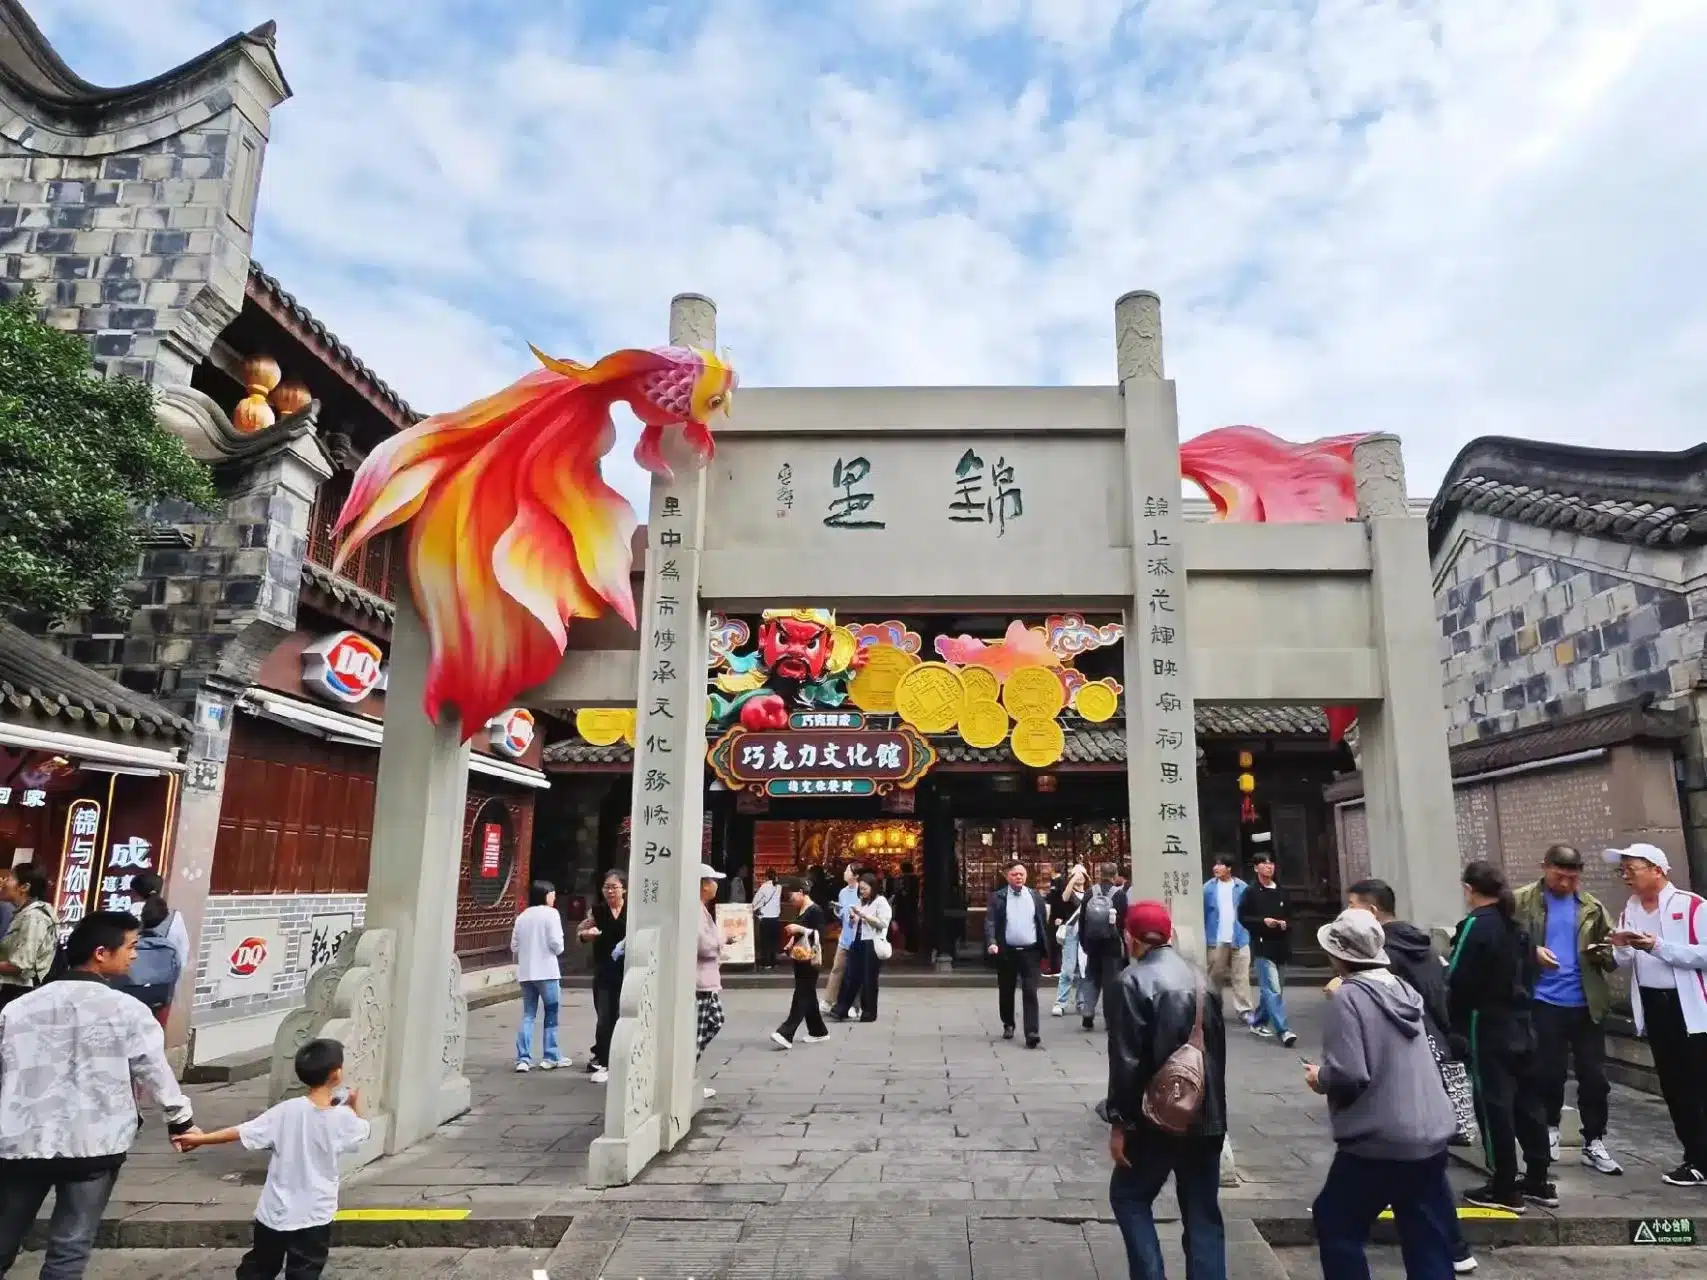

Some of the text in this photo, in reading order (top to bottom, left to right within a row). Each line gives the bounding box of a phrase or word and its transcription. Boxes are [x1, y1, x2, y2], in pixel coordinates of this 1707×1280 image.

[335, 644, 376, 687] DQ
[235, 944, 265, 967] DQ
[1652, 1218, 1691, 1233] 小心台阶
